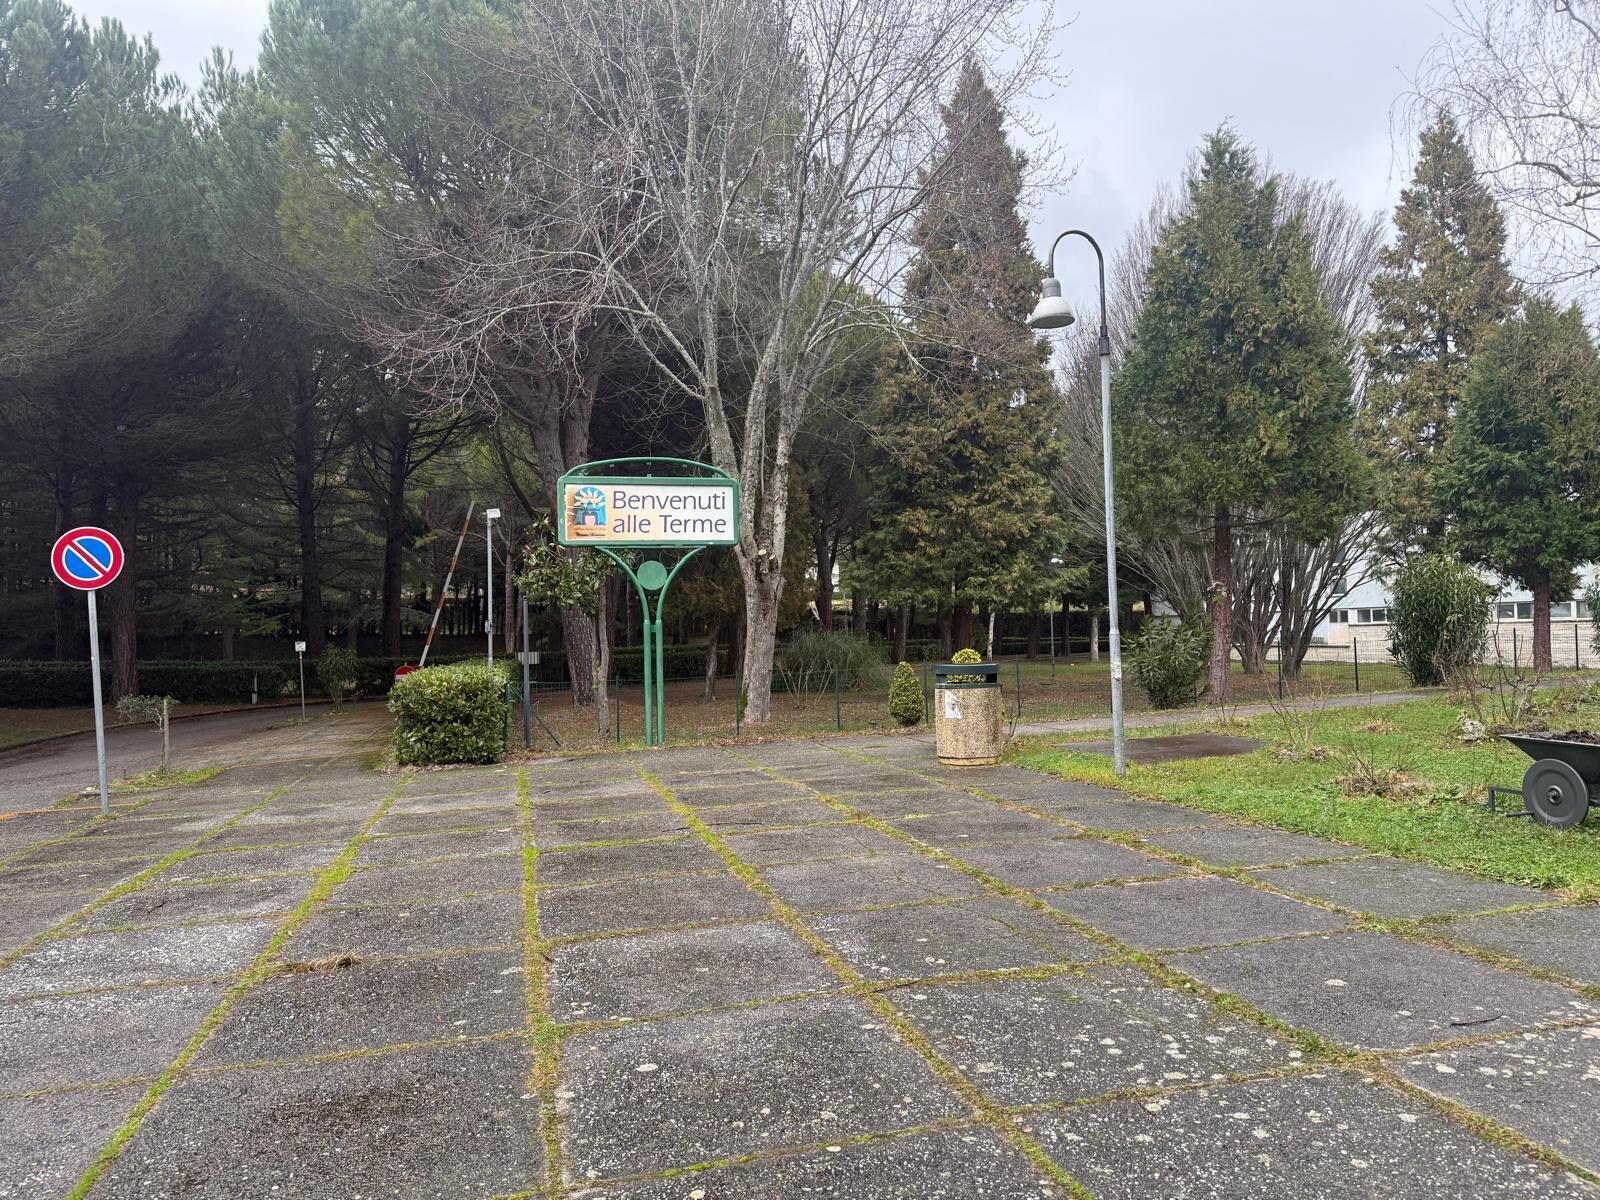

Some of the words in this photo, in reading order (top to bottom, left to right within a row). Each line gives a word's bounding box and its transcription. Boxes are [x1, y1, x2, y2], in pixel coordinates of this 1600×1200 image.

[613, 491, 726, 510] Benvenuti
[613, 515, 650, 533] alle
[659, 515, 726, 533] Terme
